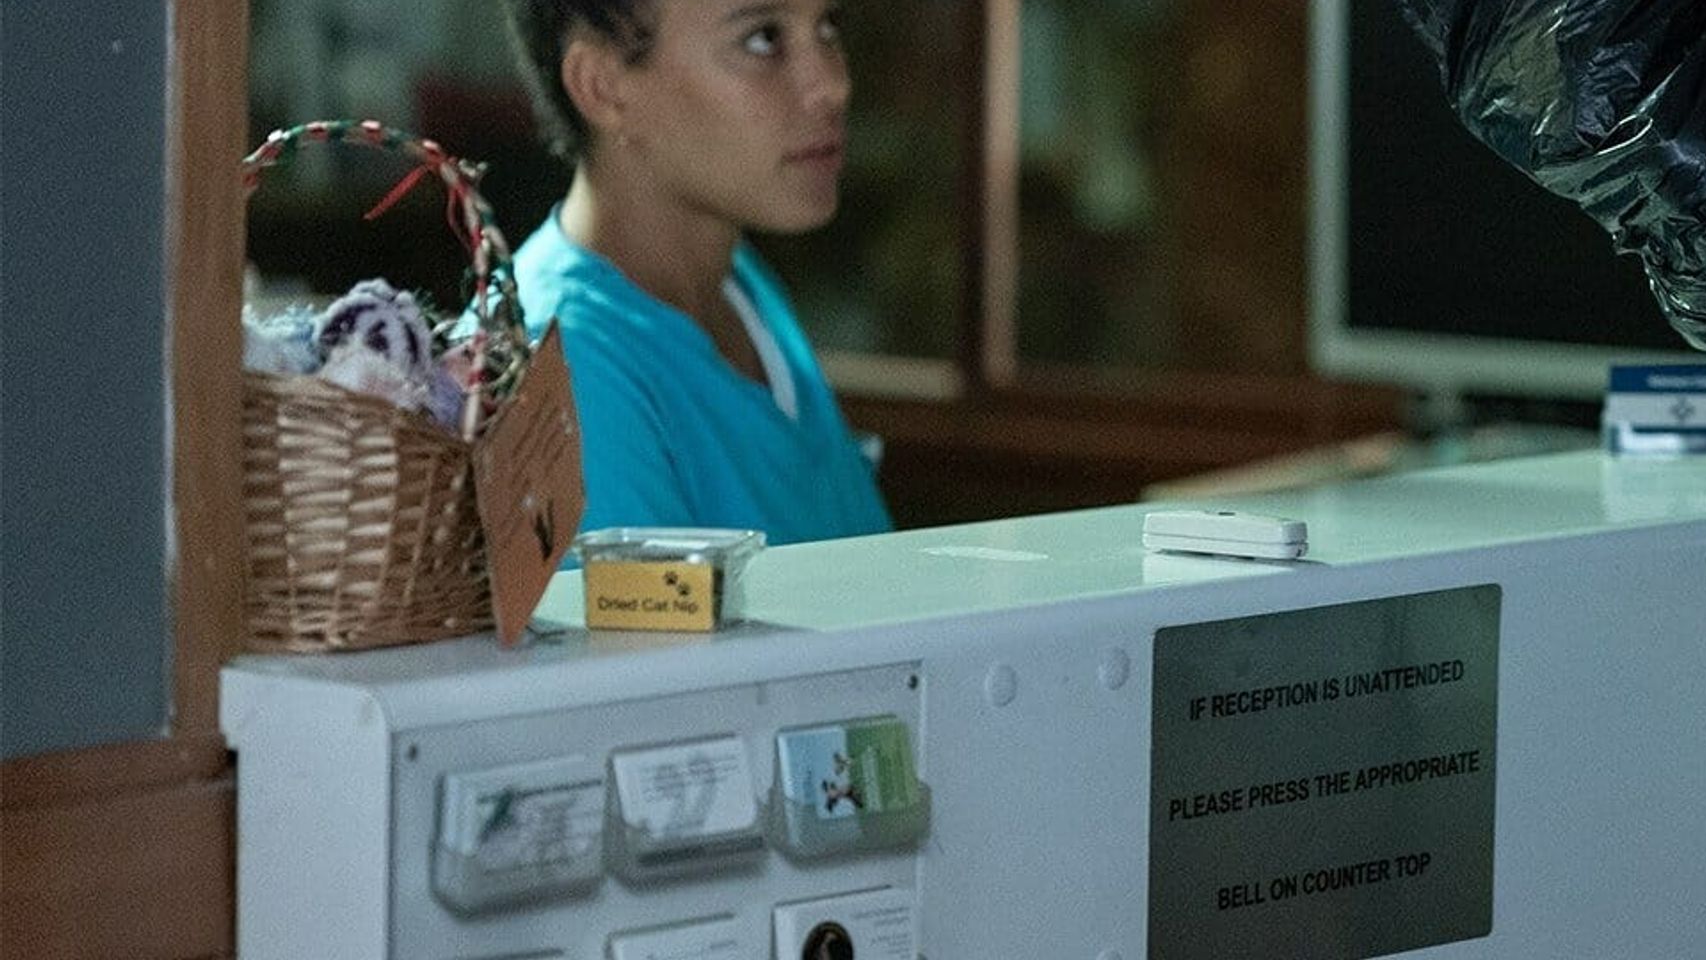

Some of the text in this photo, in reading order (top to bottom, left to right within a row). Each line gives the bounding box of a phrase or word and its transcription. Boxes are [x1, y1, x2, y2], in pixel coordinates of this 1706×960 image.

[597, 596, 699, 614] Dried Cat Nip
[1189, 659, 1464, 721] IF RECEPTION IS UNATTENDED
[1169, 750, 1480, 822] PLEASE PRESS THE APPROPRIATE
[1218, 852, 1432, 910] BELL ON COUNTER TOP
